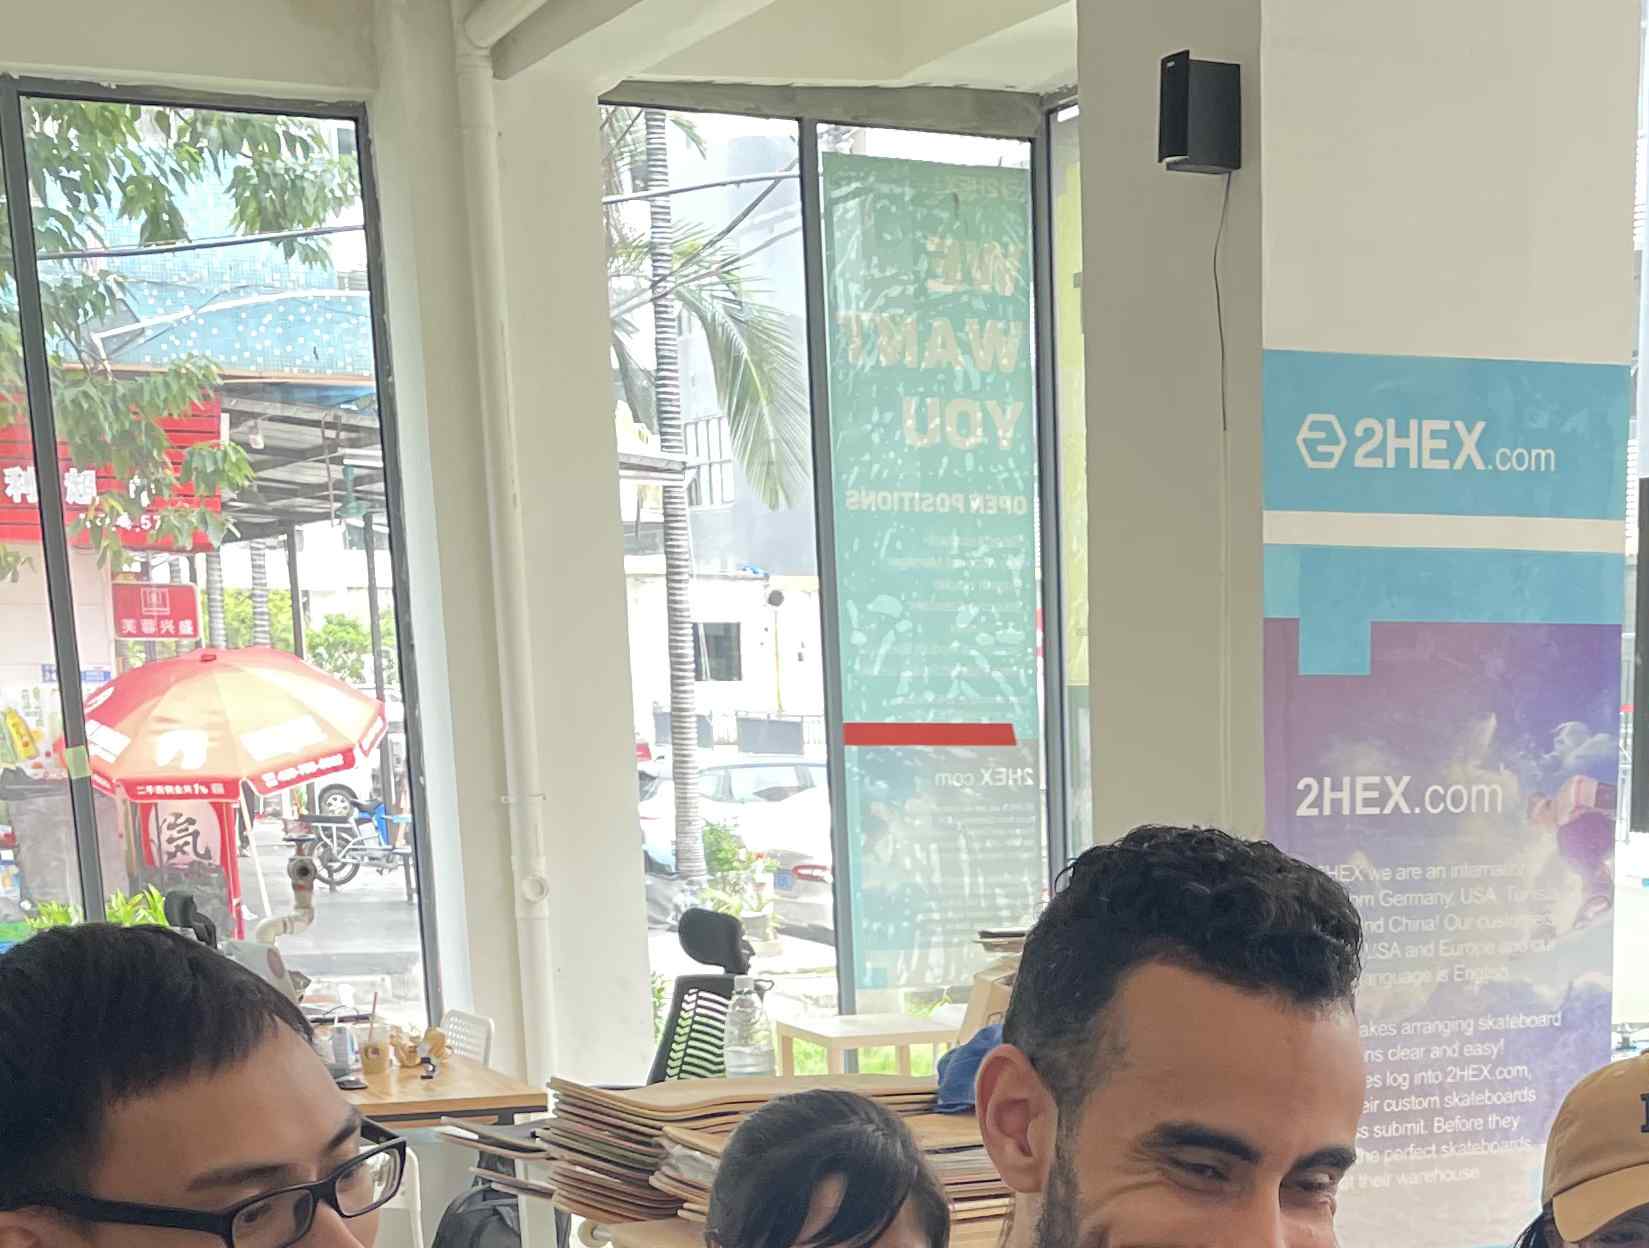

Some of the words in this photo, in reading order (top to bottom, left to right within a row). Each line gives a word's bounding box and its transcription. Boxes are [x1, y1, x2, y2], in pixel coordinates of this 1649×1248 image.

[1354, 417, 1556, 472] 2HEX.com
[1295, 774, 1504, 817] 2HEX.com
[1398, 867, 1422, 881] are
[1426, 867, 1447, 880] an
[1362, 918, 1385, 935] nd
[1406, 937, 1435, 957] and
[1359, 1022, 1397, 1038] akes
[1400, 1017, 1475, 1038] arranging
[1478, 1011, 1563, 1032] skateboard
[1388, 1044, 1427, 1061] clear
[1429, 1040, 1460, 1060] and
[1463, 1038, 1505, 1060] easy!
[1386, 1070, 1411, 1091] log
[1413, 1068, 1443, 1087] into
[1383, 1094, 1441, 1113] custom
[1443, 1086, 1538, 1109] skateboards
[1432, 1114, 1485, 1134] Before
[1488, 1111, 1521, 1133] they
